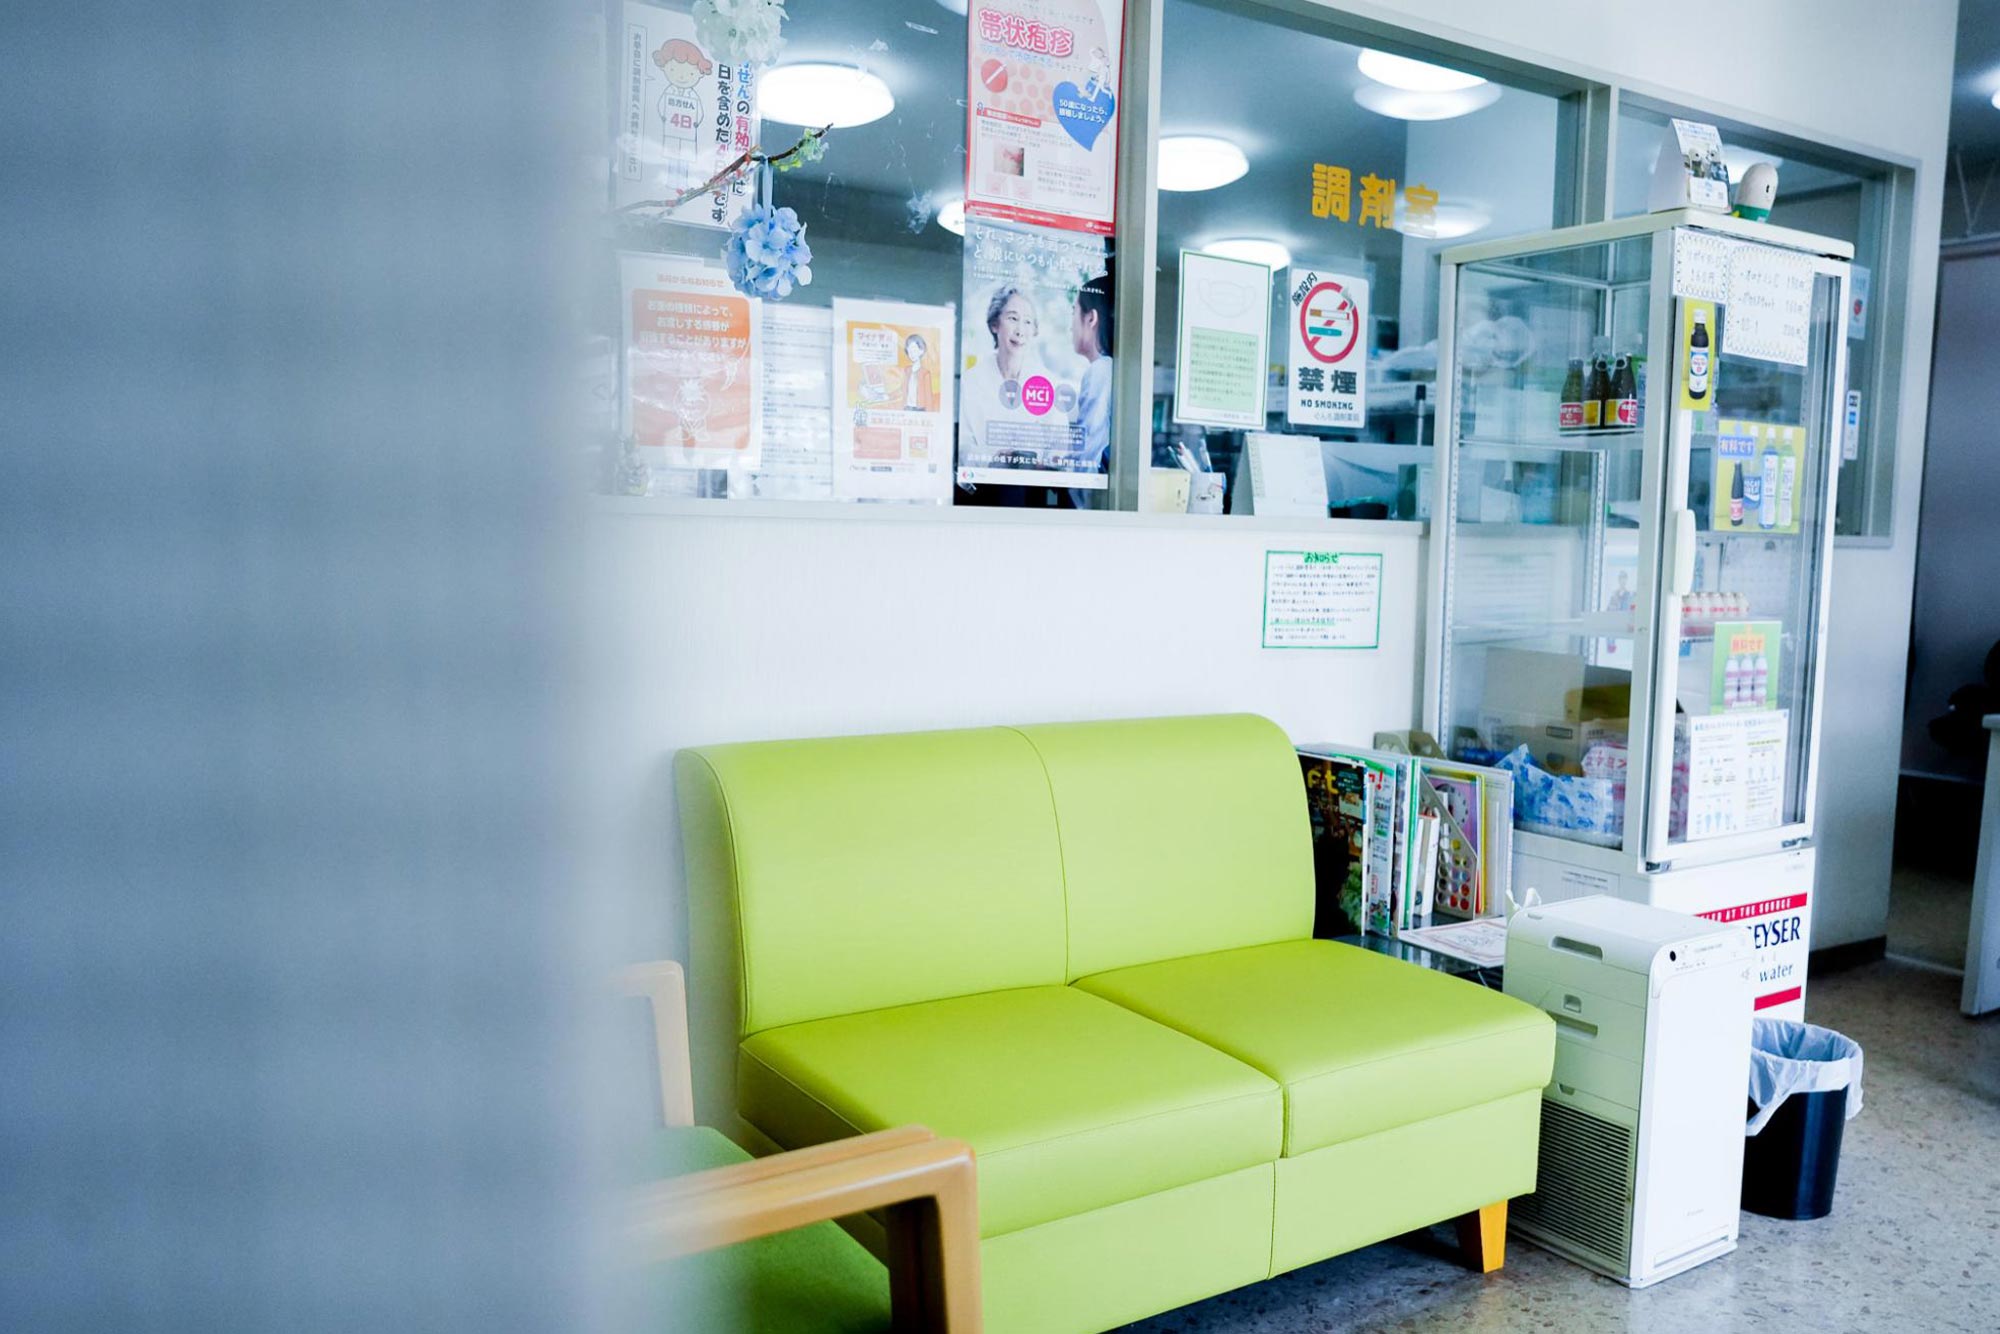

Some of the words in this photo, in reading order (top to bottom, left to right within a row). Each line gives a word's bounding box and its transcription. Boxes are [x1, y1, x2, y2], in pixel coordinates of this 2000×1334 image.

[980, 11, 1073, 56] 帯状疱疹
[670, 113, 692, 129] 4日
[1311, 162, 1439, 238] 調剤室
[1291, 272, 1318, 307] 施設内
[1298, 366, 1357, 395] 禁煙
[1026, 389, 1050, 402] MCI
[1300, 399, 1313, 408] NO
[1315, 399, 1353, 410] SMOKING
[1726, 909, 1736, 920] AT
[1740, 904, 1755, 917] THE
[1759, 898, 1792, 913] SOURCE
[1749, 916, 1800, 949] EYSER
[1759, 964, 1793, 983] water
